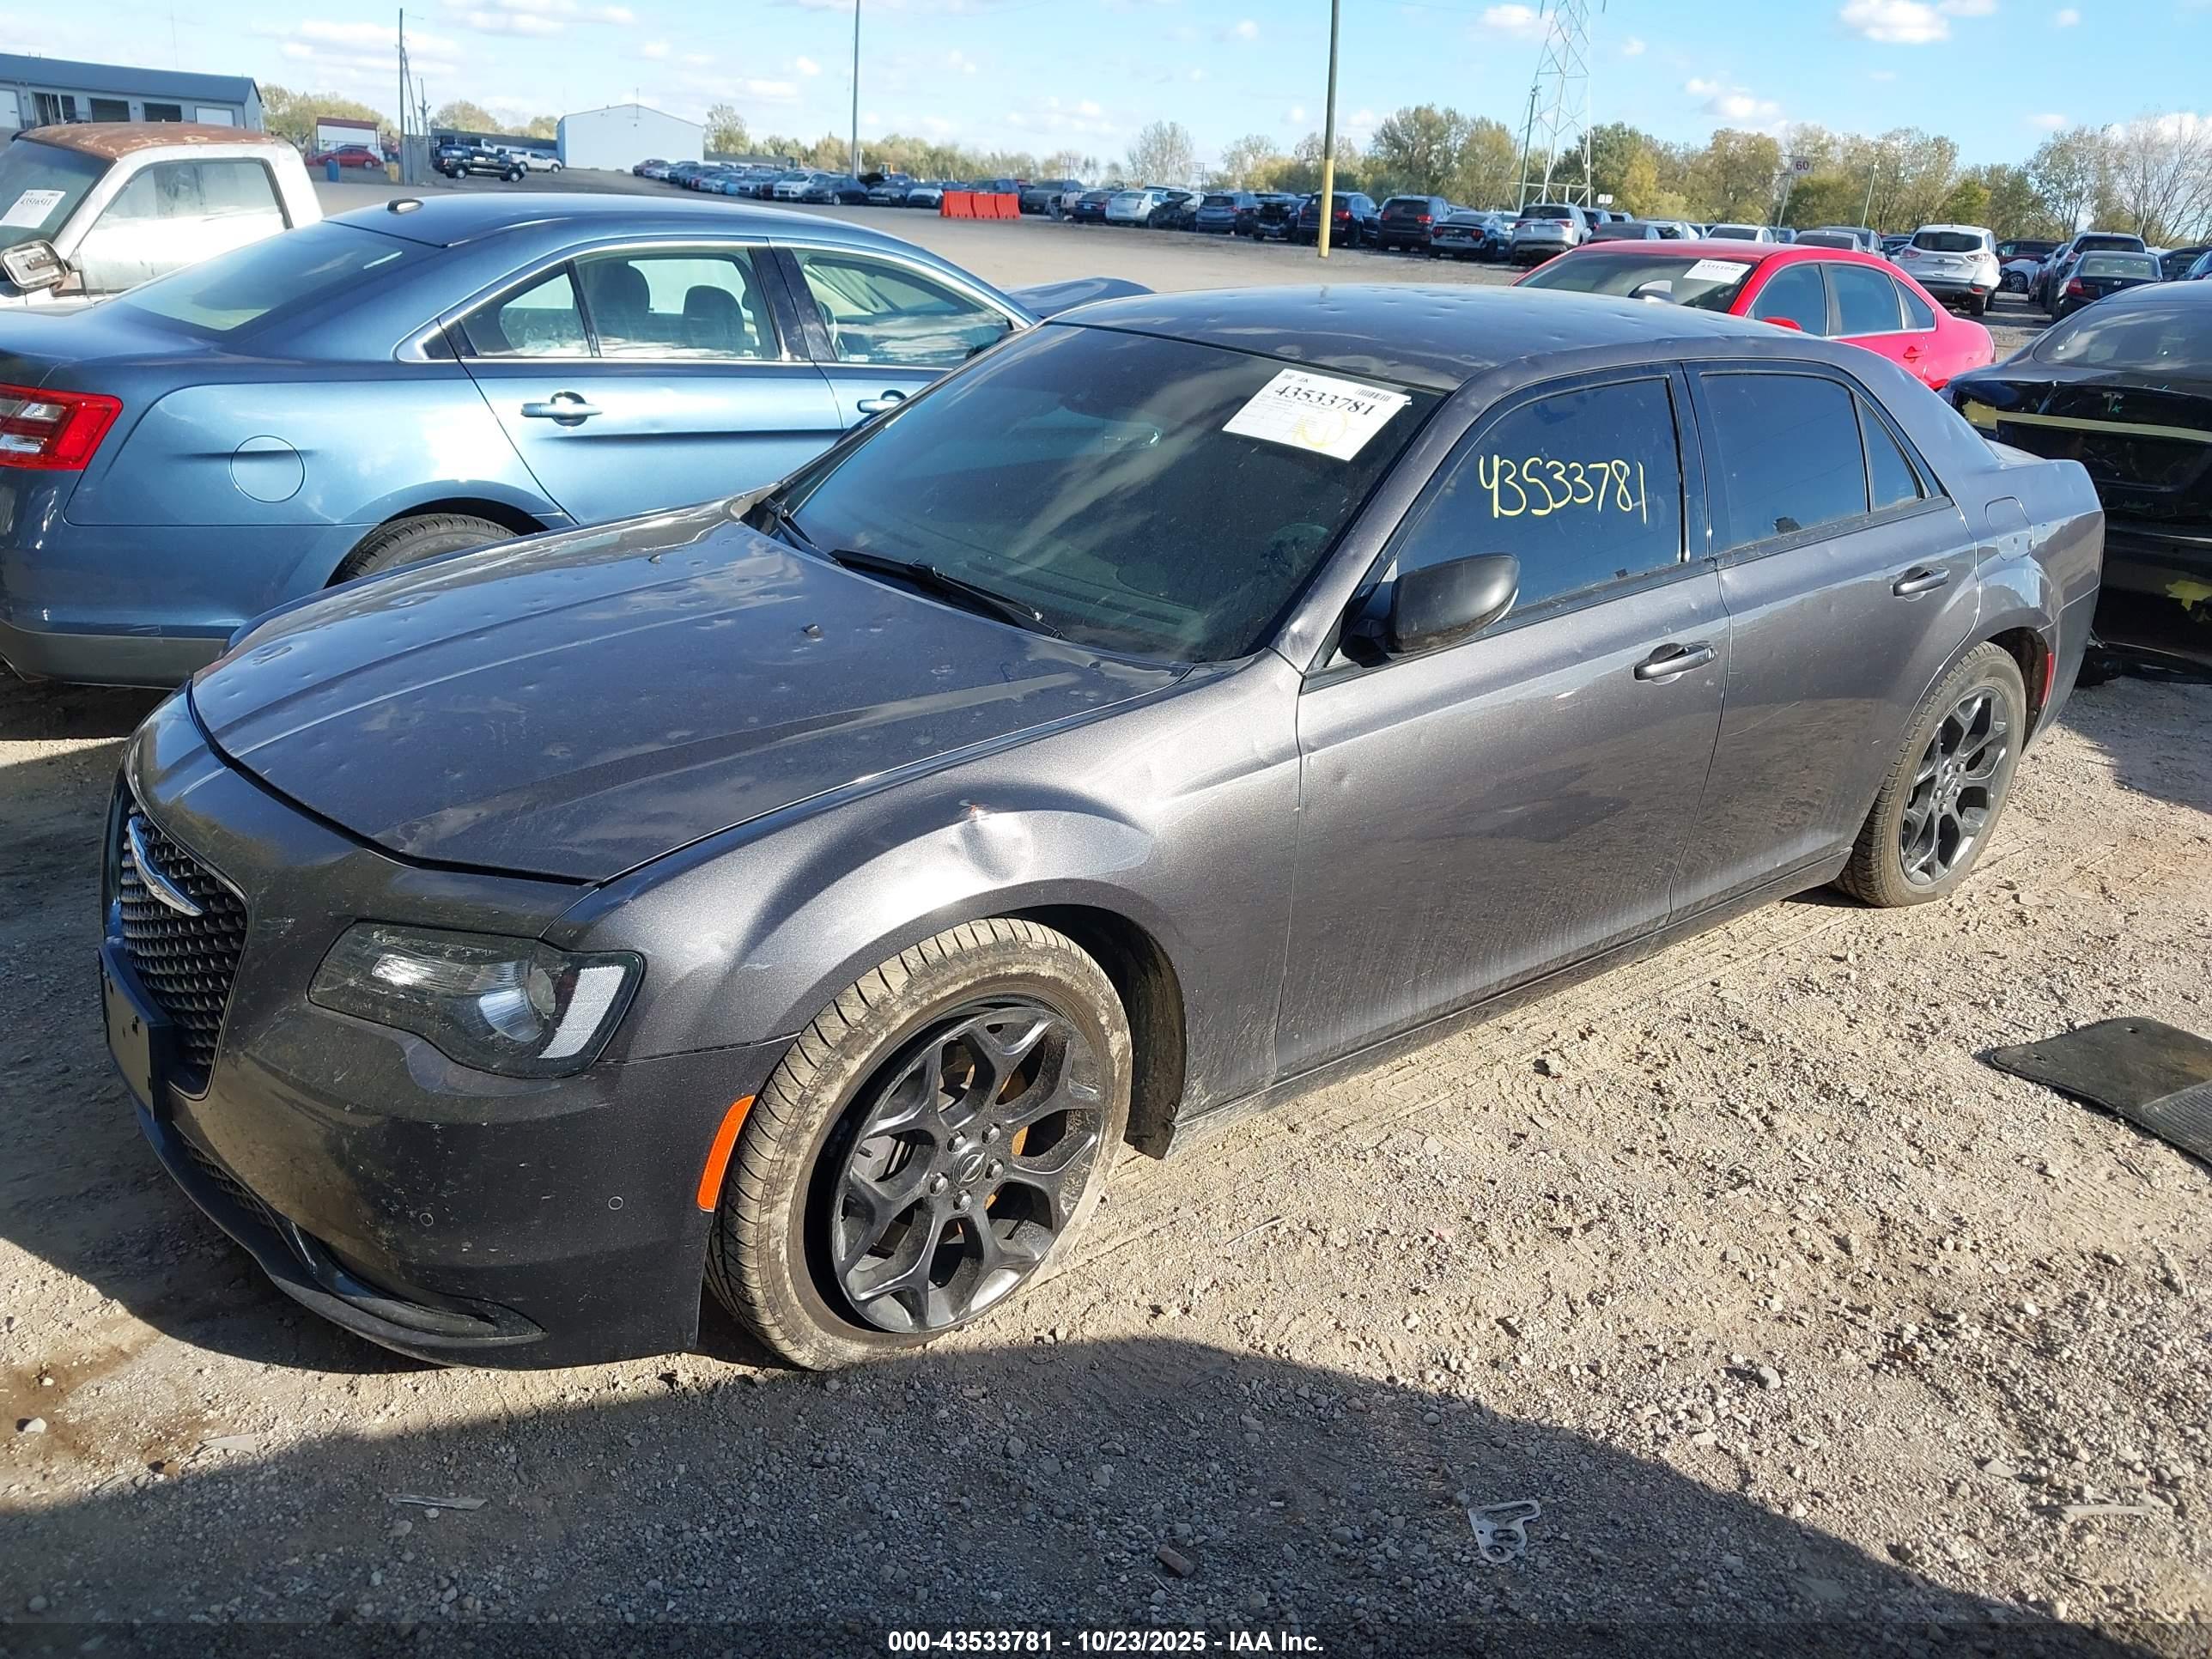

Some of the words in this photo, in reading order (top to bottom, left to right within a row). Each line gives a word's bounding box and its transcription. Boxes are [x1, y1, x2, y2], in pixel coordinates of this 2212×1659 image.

[1796, 161, 1809, 171] 60
[1274, 384, 1376, 416] 43533781
[1479, 454, 1647, 525] 43533781
